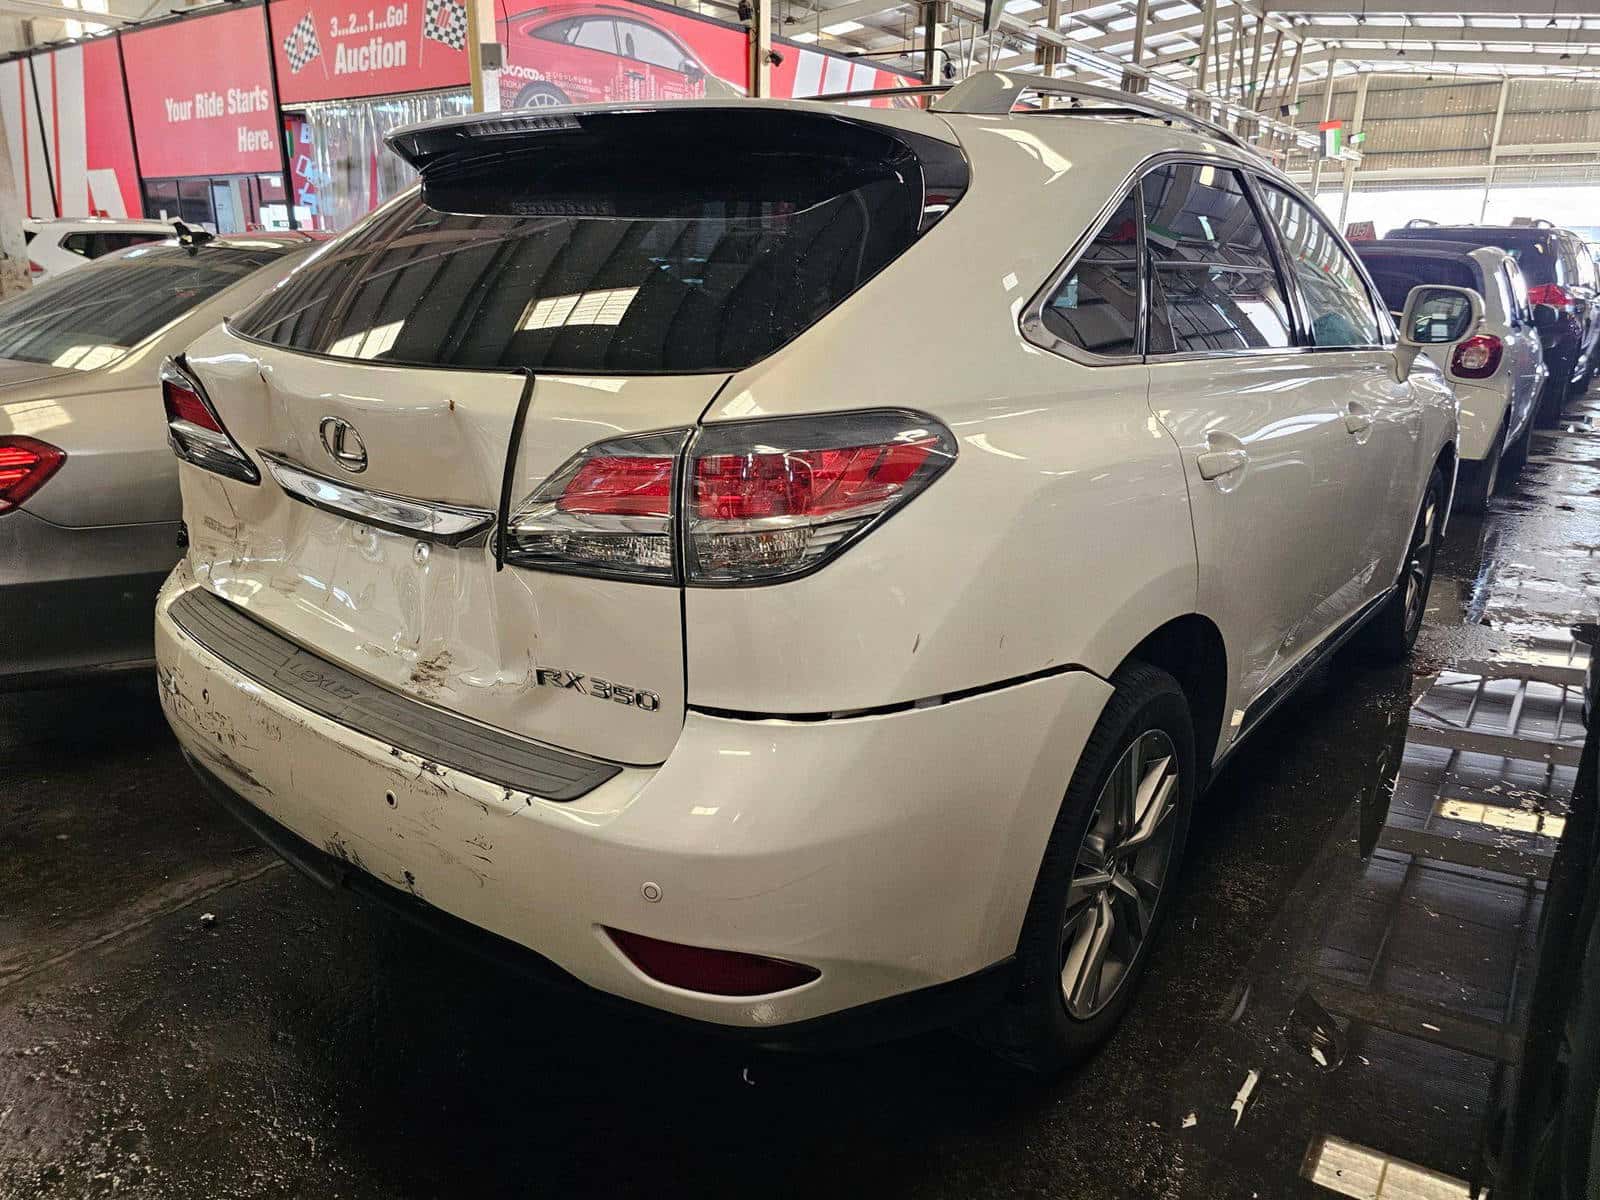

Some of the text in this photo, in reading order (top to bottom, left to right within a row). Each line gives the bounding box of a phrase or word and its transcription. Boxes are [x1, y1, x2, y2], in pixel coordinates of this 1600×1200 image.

[334, 36, 407, 75] Auction
[165, 84, 269, 123] Your Ride Starts
[237, 126, 274, 153] Here.
